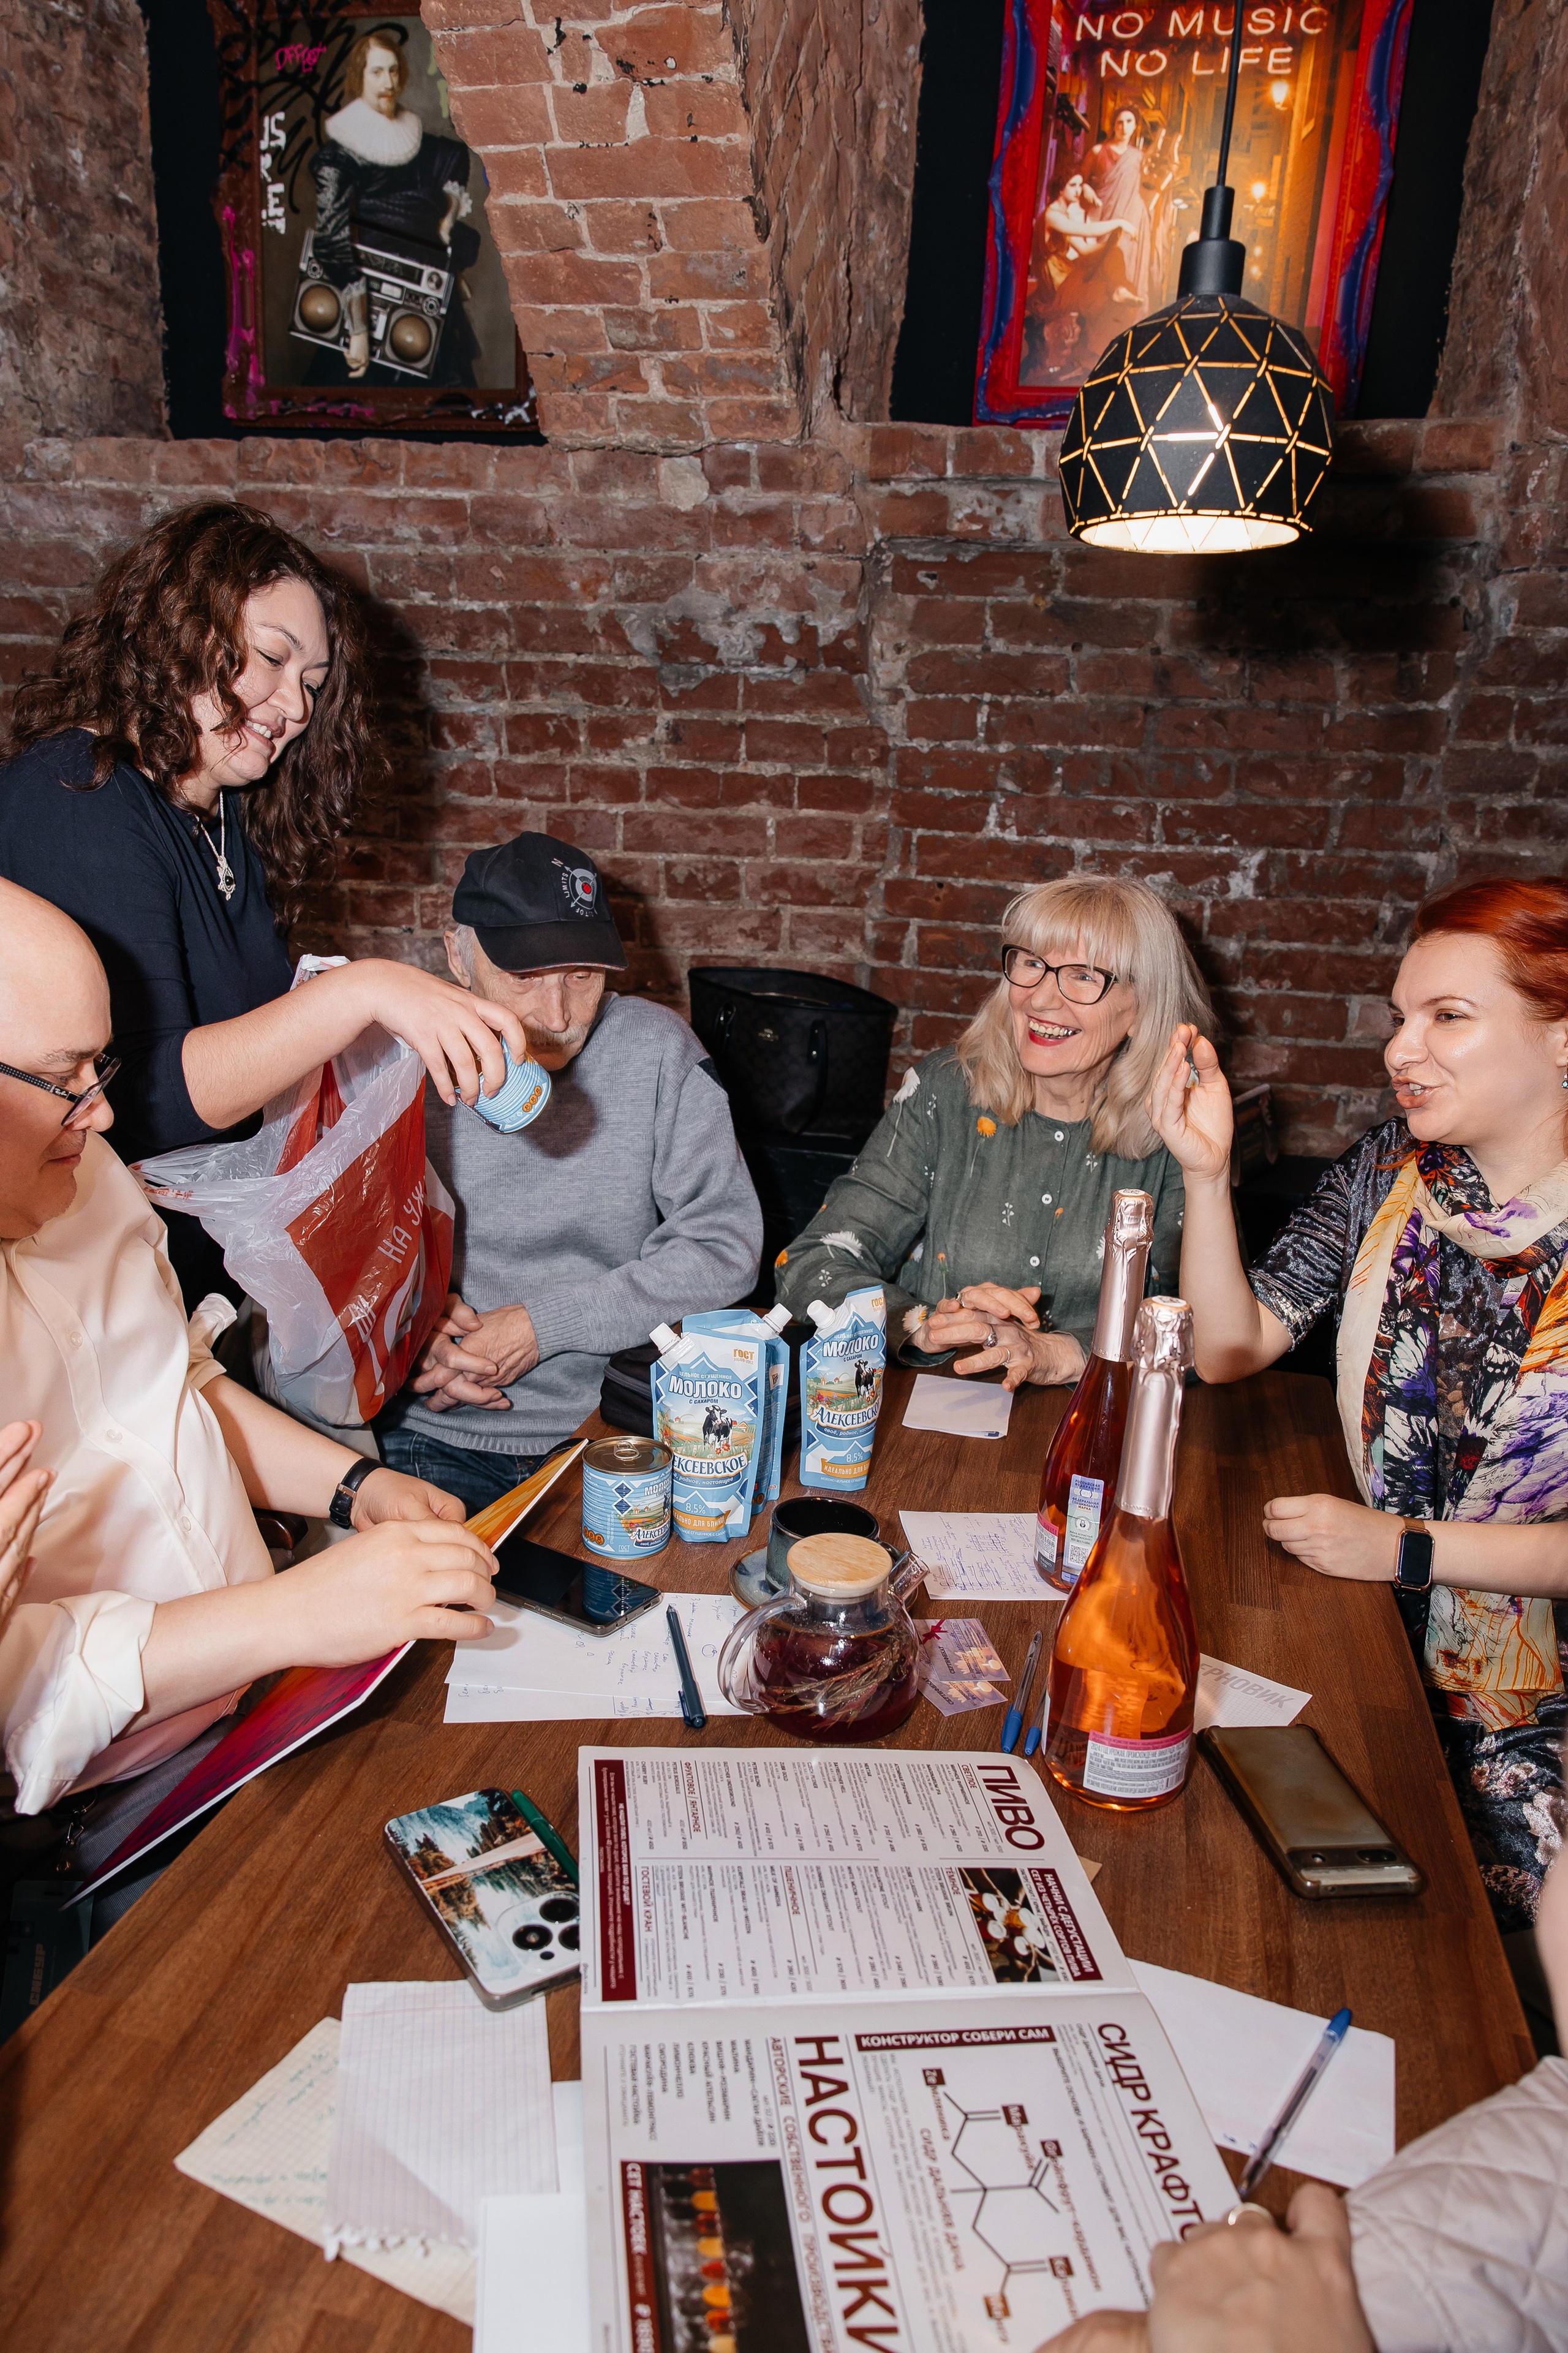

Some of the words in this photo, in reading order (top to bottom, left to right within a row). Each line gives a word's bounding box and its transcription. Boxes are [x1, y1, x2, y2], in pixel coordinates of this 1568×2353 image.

[1076, 12, 1144, 41] NO
[1169, 6, 1327, 37] MUSIC
[1101, 49, 1167, 77] NO
[1192, 46, 1293, 75] LIFE
[377, 1225, 412, 1264] НА
[403, 1175, 425, 1225] УЖ
[733, 1349, 754, 1360] ГОСТ
[823, 1334, 879, 1357] МОЛОКО
[668, 1375, 742, 1399] МОЛОКО
[673, 1454, 746, 1474] ЕКСЕЕВСКОЕ
[824, 1465, 852, 1475] ИДЕАЛЬНО
[679, 1476, 701, 1485] родное,
[686, 1503, 706, 1514] 8,5%
[1072, 1497, 1099, 1505] ФЕДЕРАЛЬНАЯ
[1072, 1500, 1099, 1509] СПЕЦИАЛЬНАЯ
[674, 1513, 691, 1525] ЕАЛЬНО
[693, 1519, 704, 1528] ДЛЯ
[1200, 1663, 1295, 1709] ЕРНОВИК
[684, 1762, 695, 1794] ФРУКТОВОЕ
[960, 1764, 977, 1788] СВЕТЛОЕ
[688, 1800, 701, 1832] ЯНТАРНОЕ
[976, 1766, 1048, 1850] ПИВО
[641, 1866, 652, 1906] ГОСТЕВОЙ
[944, 1867, 962, 1895] ТЁМНОЕ
[1030, 1870, 1042, 1881] СЕТ
[1035, 1882, 1046, 1892] ИЗ
[783, 1865, 800, 1915] ПШЕНИЧНОЕ
[643, 1909, 652, 1932] КРАН
[1040, 1893, 1060, 1924] ЧЕТЫРЁХ
[1043, 1874, 1063, 1904] НАЧНИ
[1057, 1913, 1094, 1972] ДЕГУСТАЦИИ
[1052, 1925, 1071, 1952] СОРТОВ
[1065, 1955, 1082, 1977] ПИВА
[861, 2031, 960, 2048] КОНСТРУКТОР
[962, 2029, 1017, 2043] СОБЕРИ
[1019, 2027, 1049, 2040] САМ
[1097, 2023, 1152, 2101] СИДР
[770, 2036, 791, 2105] АВТОРСКИЕ
[781, 2115, 813, 2223] СОБСТВЕННОГО
